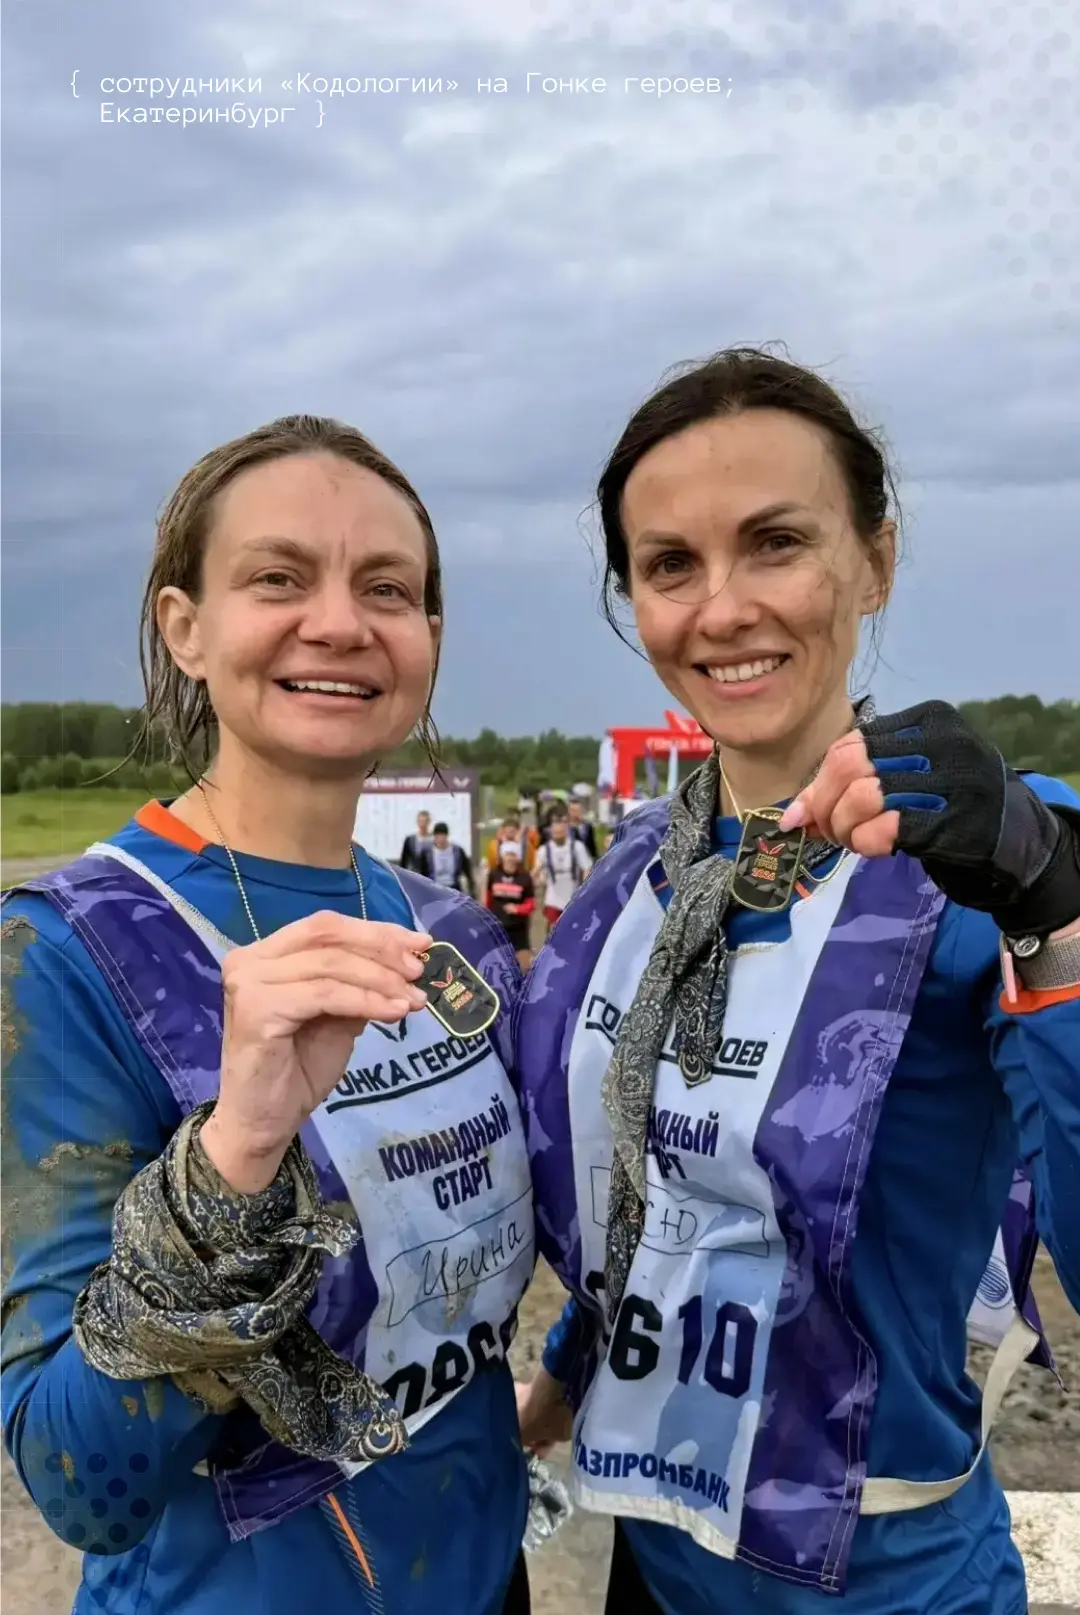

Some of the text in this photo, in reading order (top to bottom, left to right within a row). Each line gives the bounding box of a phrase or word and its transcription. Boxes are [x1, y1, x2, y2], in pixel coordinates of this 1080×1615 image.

[323, 1059, 422, 1102] ОНКА
[378, 1093, 512, 1182] КОМАНДНЫЙ
[645, 1105, 720, 1158] НДНЫЙ
[432, 1156, 493, 1211] СТАРТ
[421, 1221, 526, 1296] Ирина
[585, 1270, 758, 1399] 610
